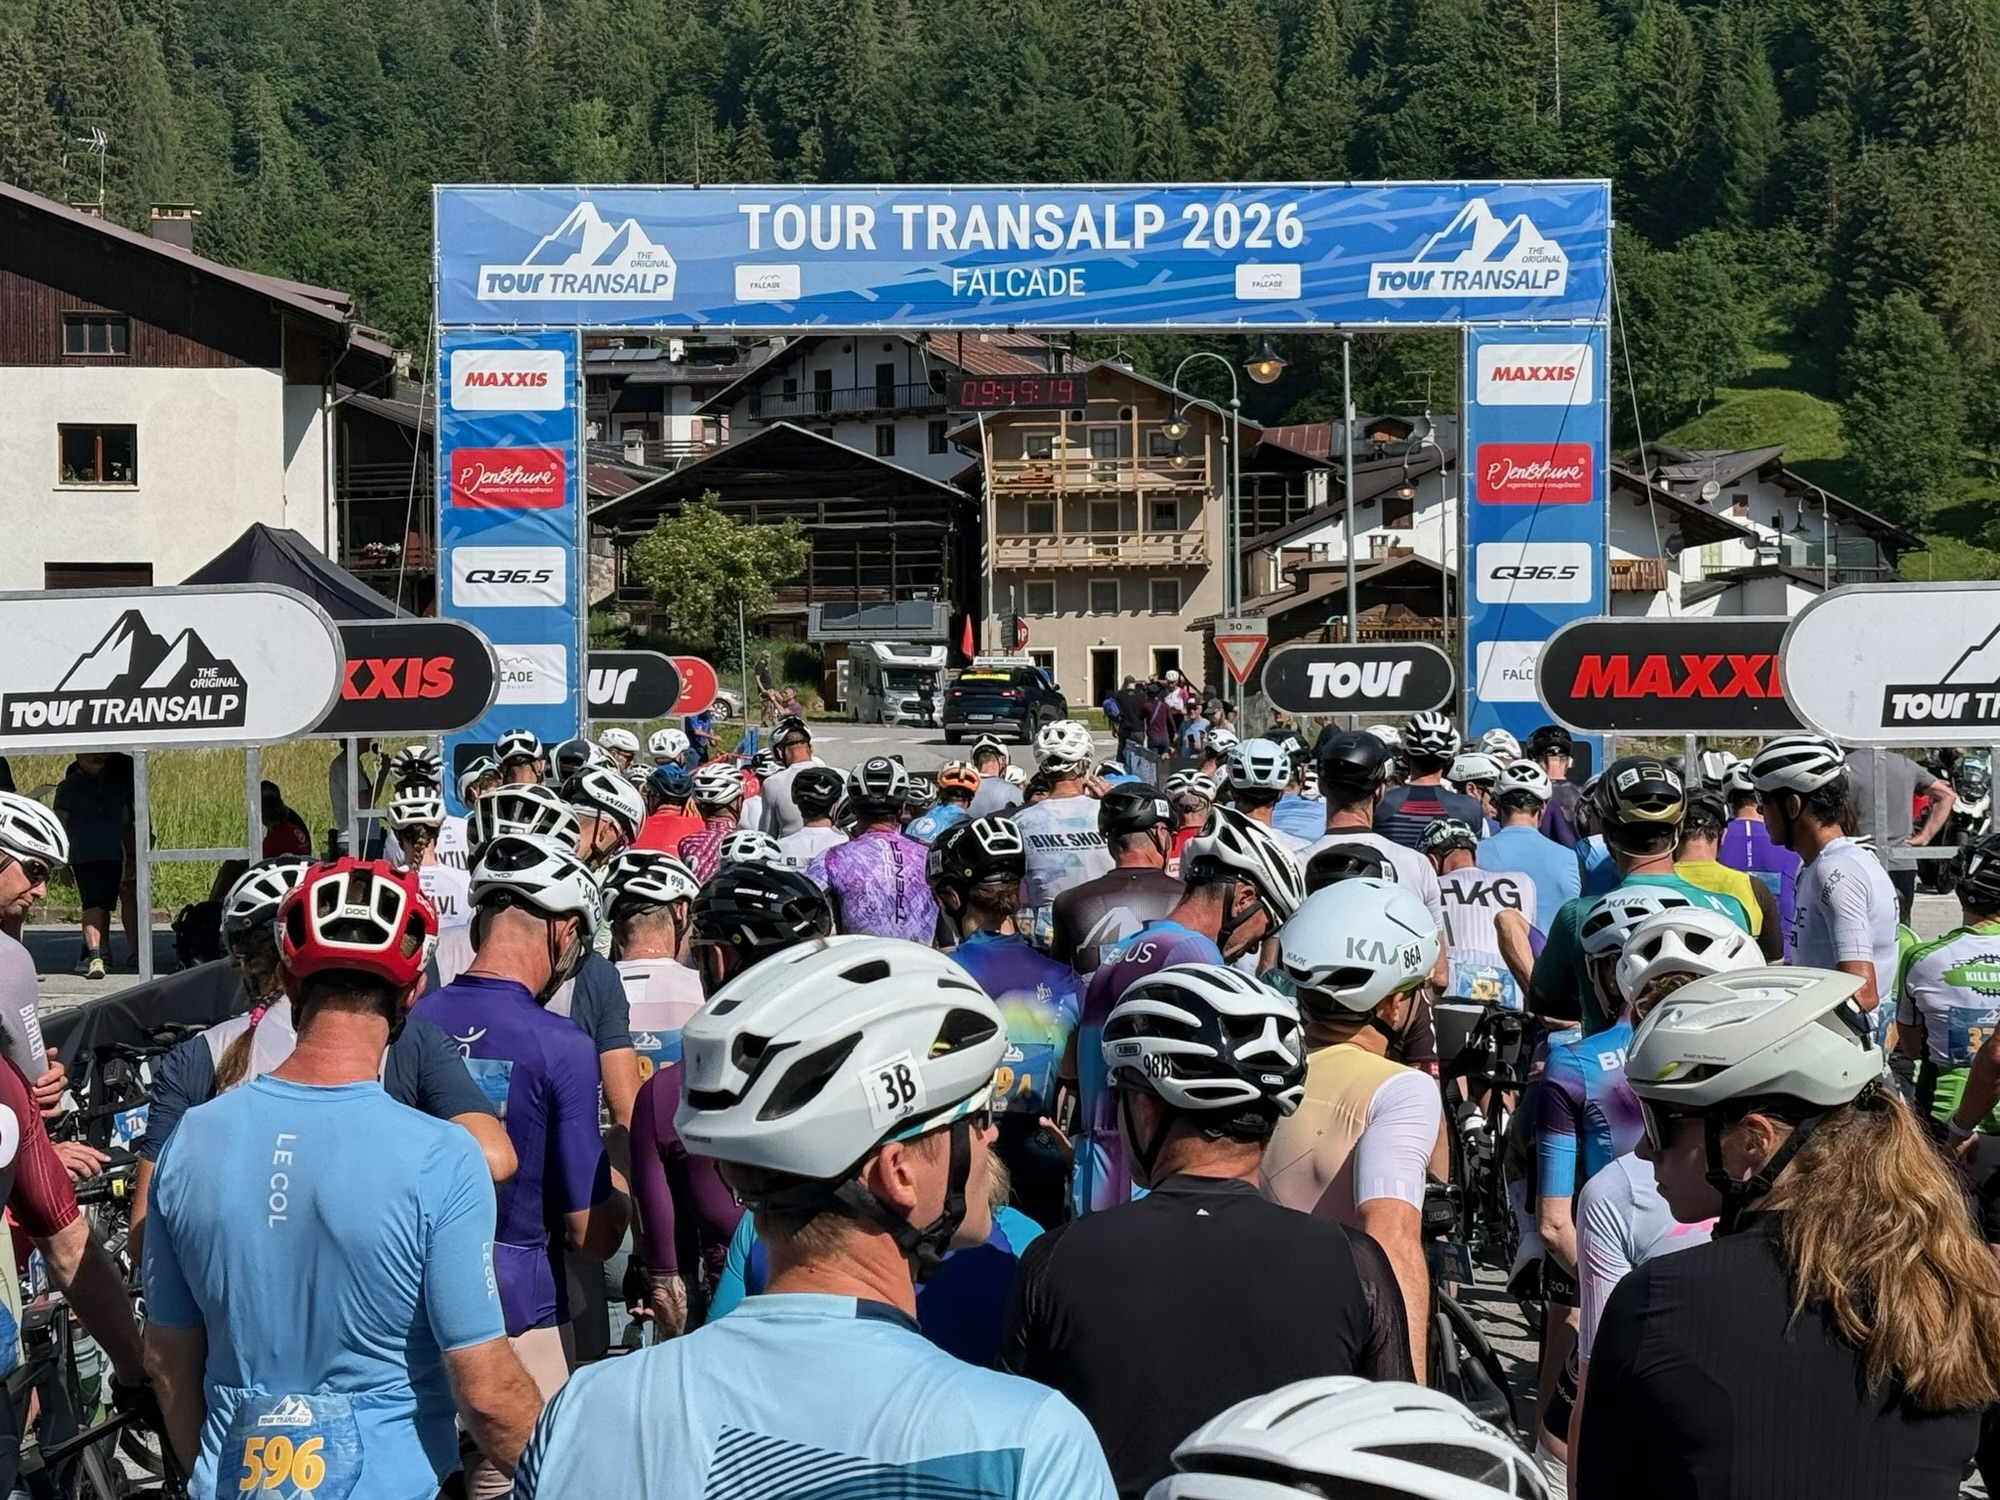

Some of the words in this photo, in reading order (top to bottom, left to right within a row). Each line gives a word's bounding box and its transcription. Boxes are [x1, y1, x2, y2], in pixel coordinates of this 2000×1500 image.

[738, 203, 877, 251] TOUR
[892, 203, 1166, 250] TRANSALP
[1181, 202, 1304, 249] 2026
[636, 252, 654, 260] THE
[1521, 255, 1562, 264] ORIGINAL
[1528, 247, 1545, 255] THE
[630, 260, 670, 269] ORIGINAL
[549, 273, 669, 294] TRANSALP
[951, 267, 1086, 298] FALCADE
[1440, 269, 1560, 290] TRANSALP
[464, 372, 548, 387] MAXXIS
[1490, 366, 1576, 382] MAXXIS
[465, 569, 554, 584] Q36.5
[1490, 566, 1580, 580] Q36.5
[1229, 623, 1243, 631] 50
[197, 667, 219, 678] THE
[190, 677, 240, 689] ORIGINAL
[88, 694, 239, 725] TRANSALP
[1029, 833, 1069, 849] BIKE
[1440, 878, 1523, 912] HKG
[1403, 944, 1422, 969] 86A
[1965, 970, 1986, 982] KILL
[18, 1003, 45, 1062] BIEHLER
[1143, 1054, 1172, 1079] 98B
[879, 1063, 917, 1110] 3B
[272, 1133, 297, 1166] LE
[268, 1172, 289, 1229] COL
[239, 1435, 325, 1492] 596
